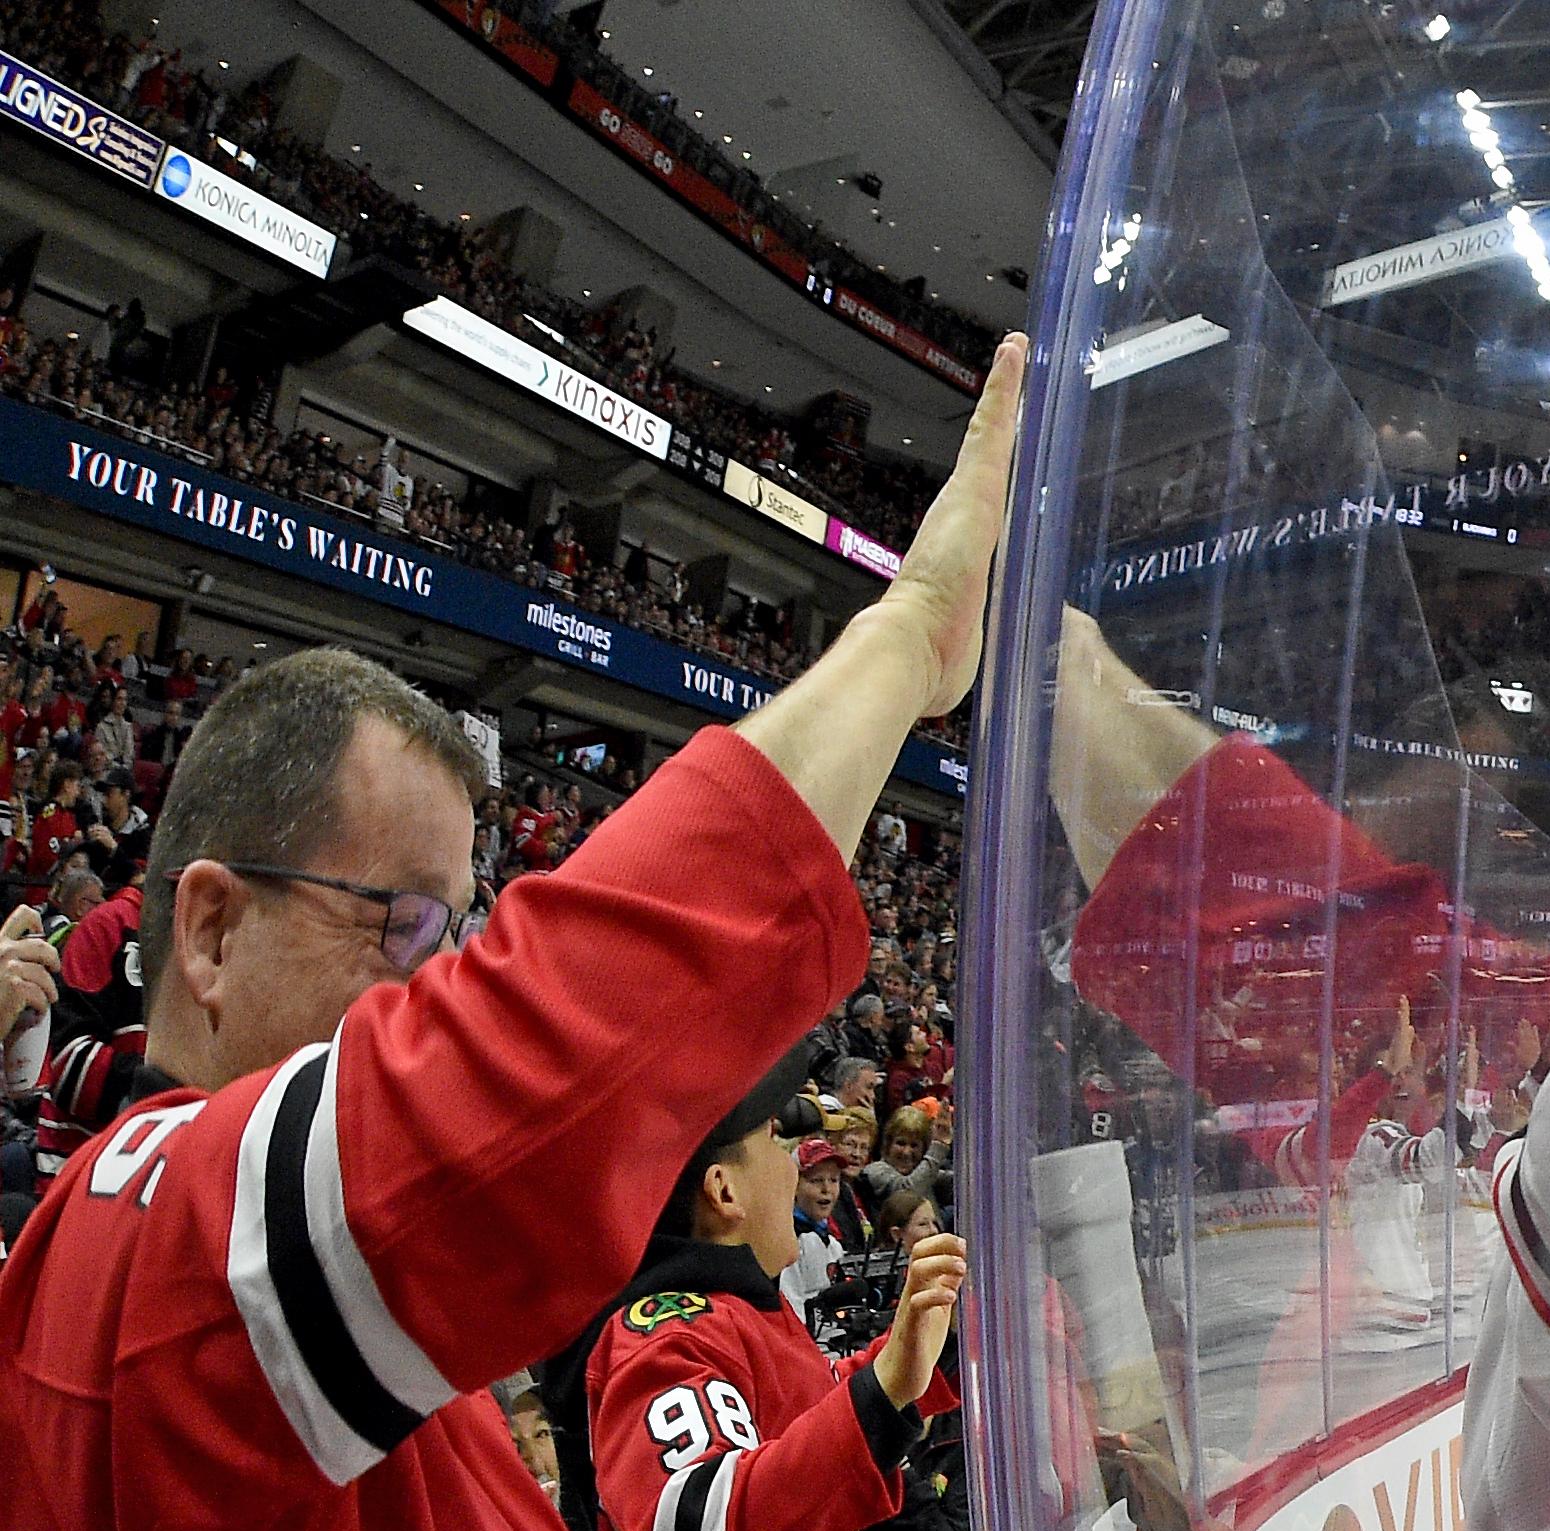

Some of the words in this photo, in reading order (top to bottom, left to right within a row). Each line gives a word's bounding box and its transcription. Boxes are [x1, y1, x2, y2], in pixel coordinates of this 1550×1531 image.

[195, 178, 257, 230] KONICA
[261, 214, 330, 267] MINOLTA
[67, 441, 158, 506] YOUR
[169, 477, 297, 553] TABLE'S
[306, 526, 434, 598] WAITING
[766, 491, 805, 526] Stantec
[526, 603, 612, 651] milestones
[682, 661, 734, 704] YOUR
[647, 1381, 760, 1471] 98
